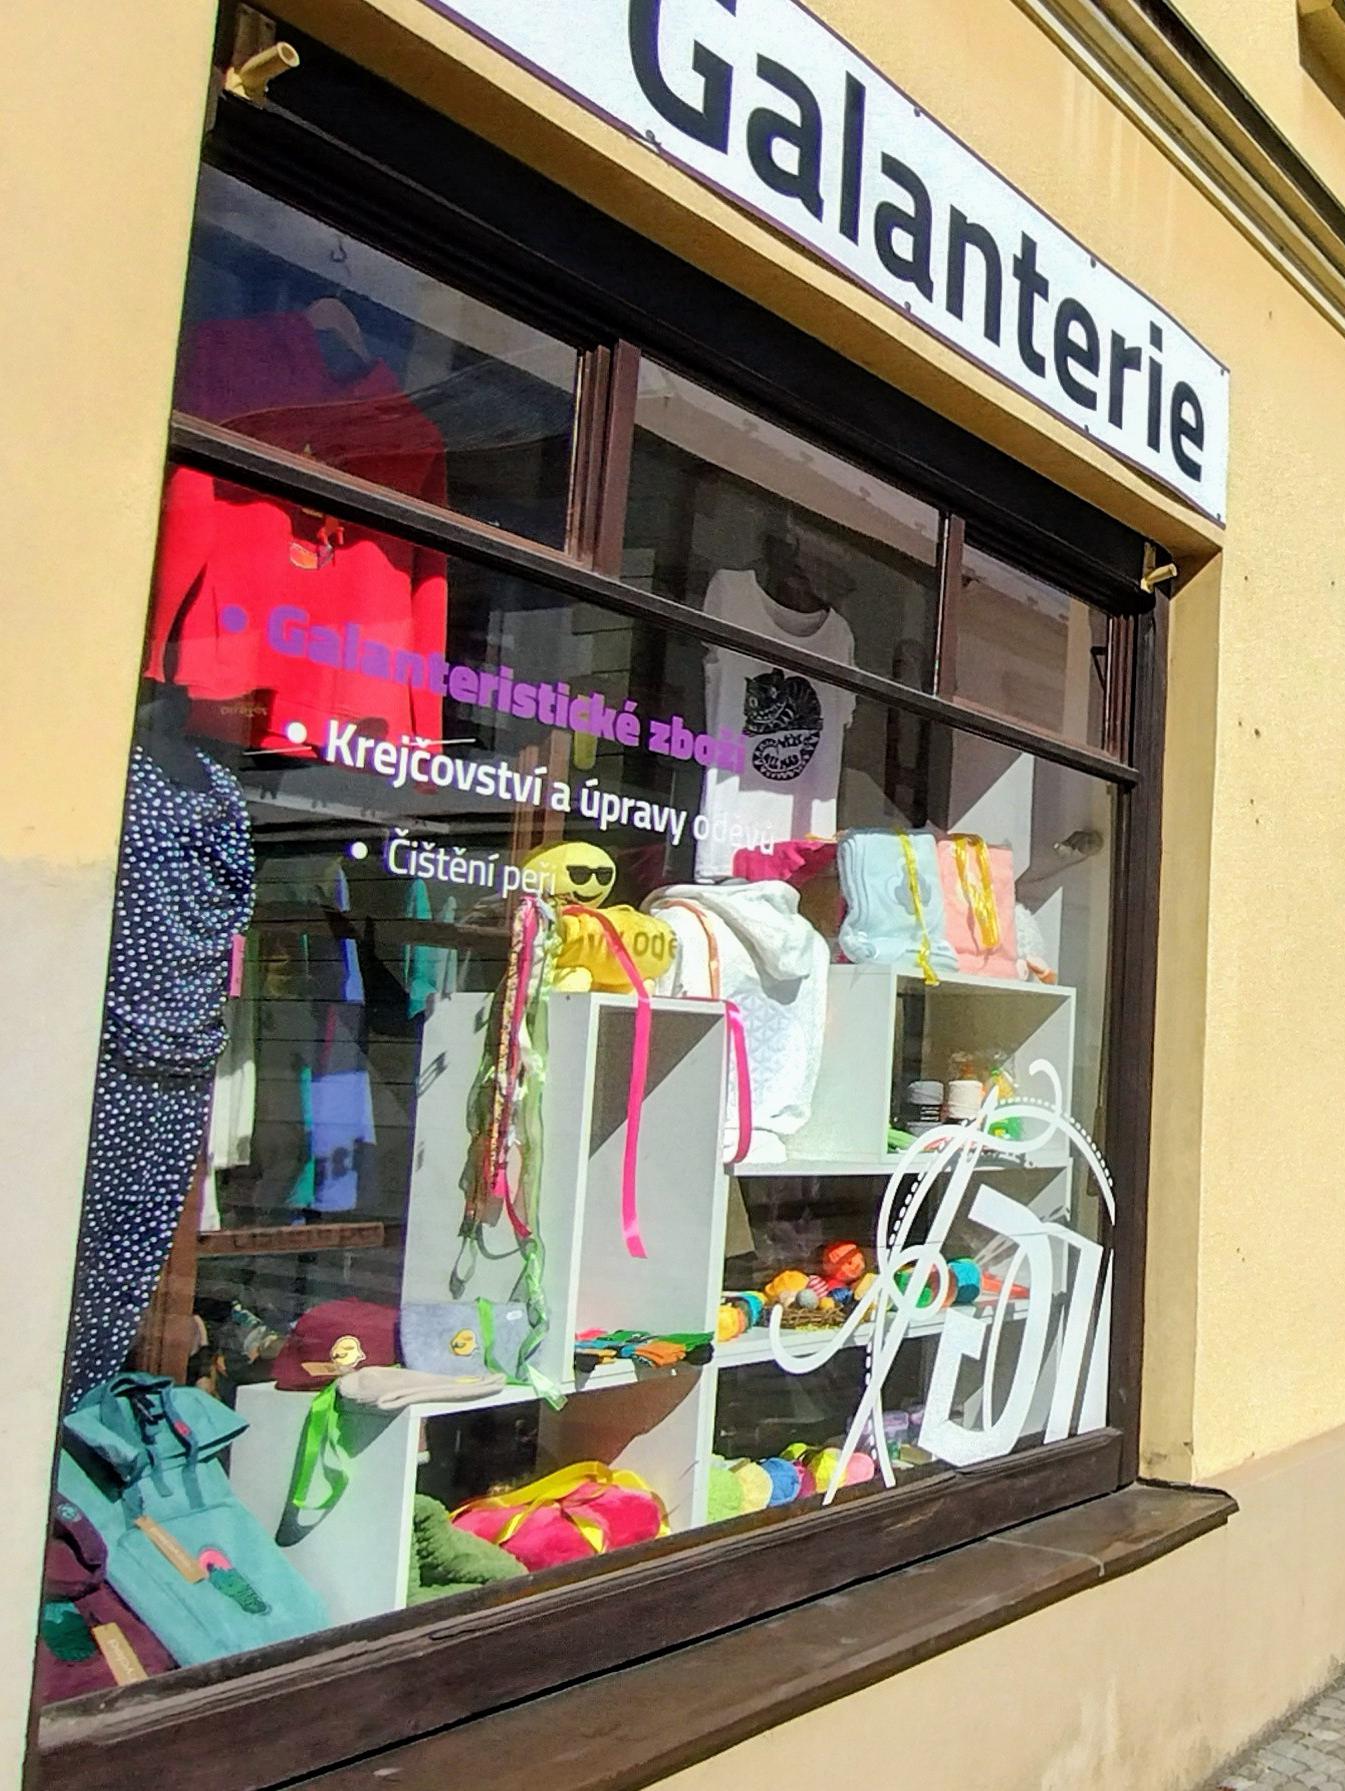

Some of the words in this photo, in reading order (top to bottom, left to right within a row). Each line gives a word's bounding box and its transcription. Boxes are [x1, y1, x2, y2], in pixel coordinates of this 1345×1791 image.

[628, 0, 1204, 483] Galanterie
[267, 603, 641, 747] Galanteristické
[325, 720, 547, 806] Krejčovství
[551, 782, 571, 812] a
[580, 778, 687, 846] úpravy
[388, 827, 500, 887] Čištění
